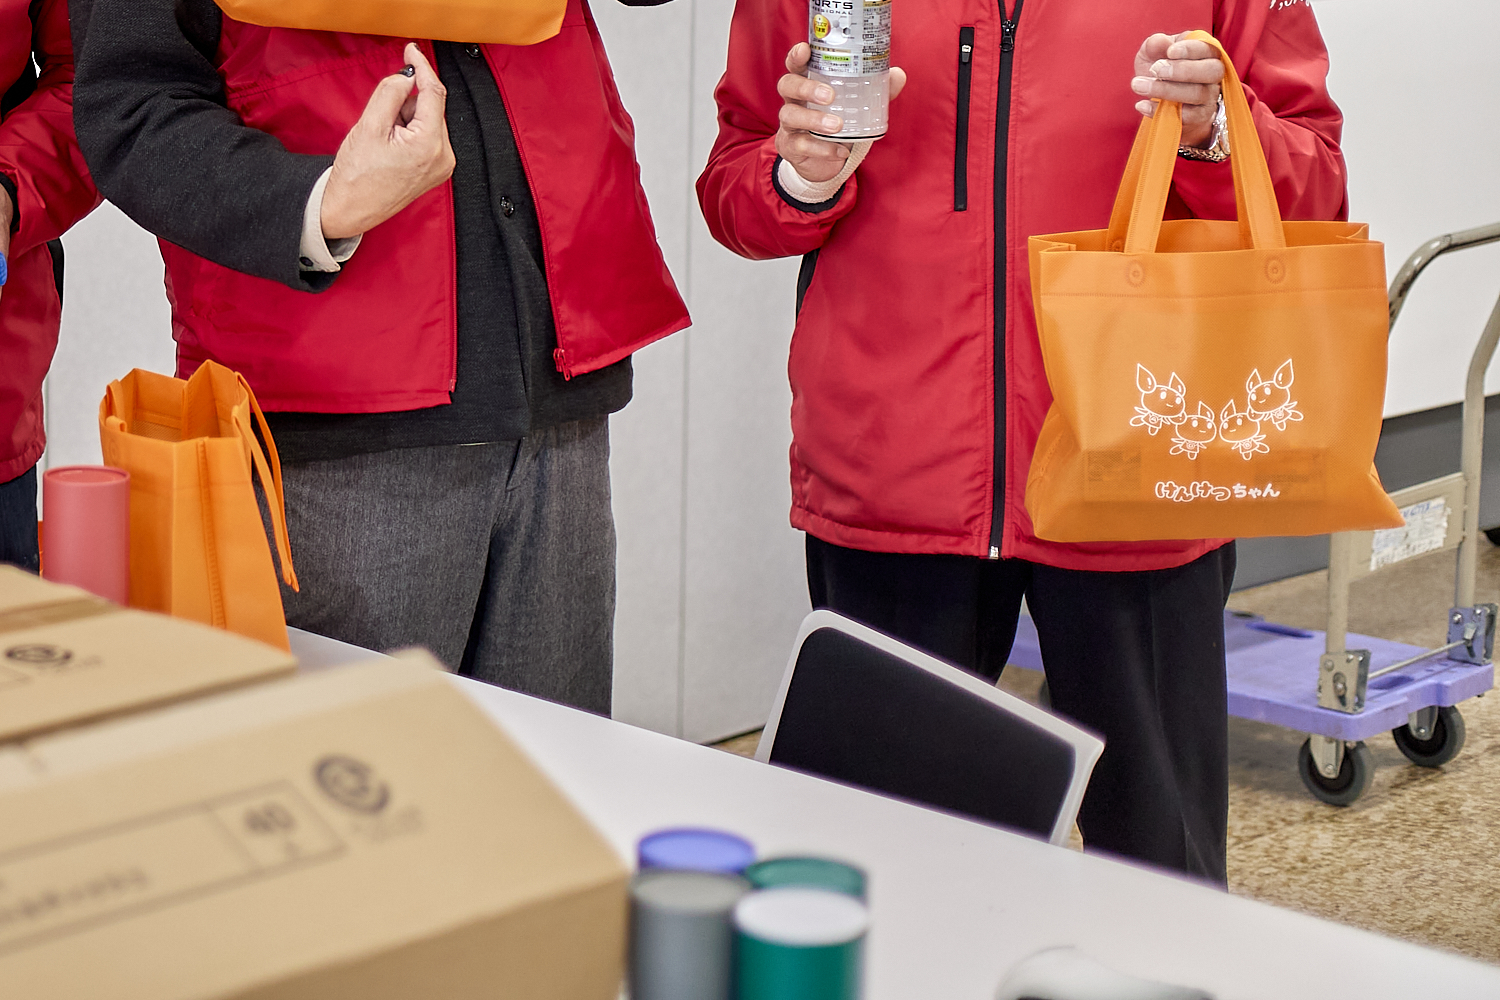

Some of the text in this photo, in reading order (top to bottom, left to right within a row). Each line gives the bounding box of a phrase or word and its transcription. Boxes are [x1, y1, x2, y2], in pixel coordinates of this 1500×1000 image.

[1154, 481, 1281, 503] けんけつちゃん
